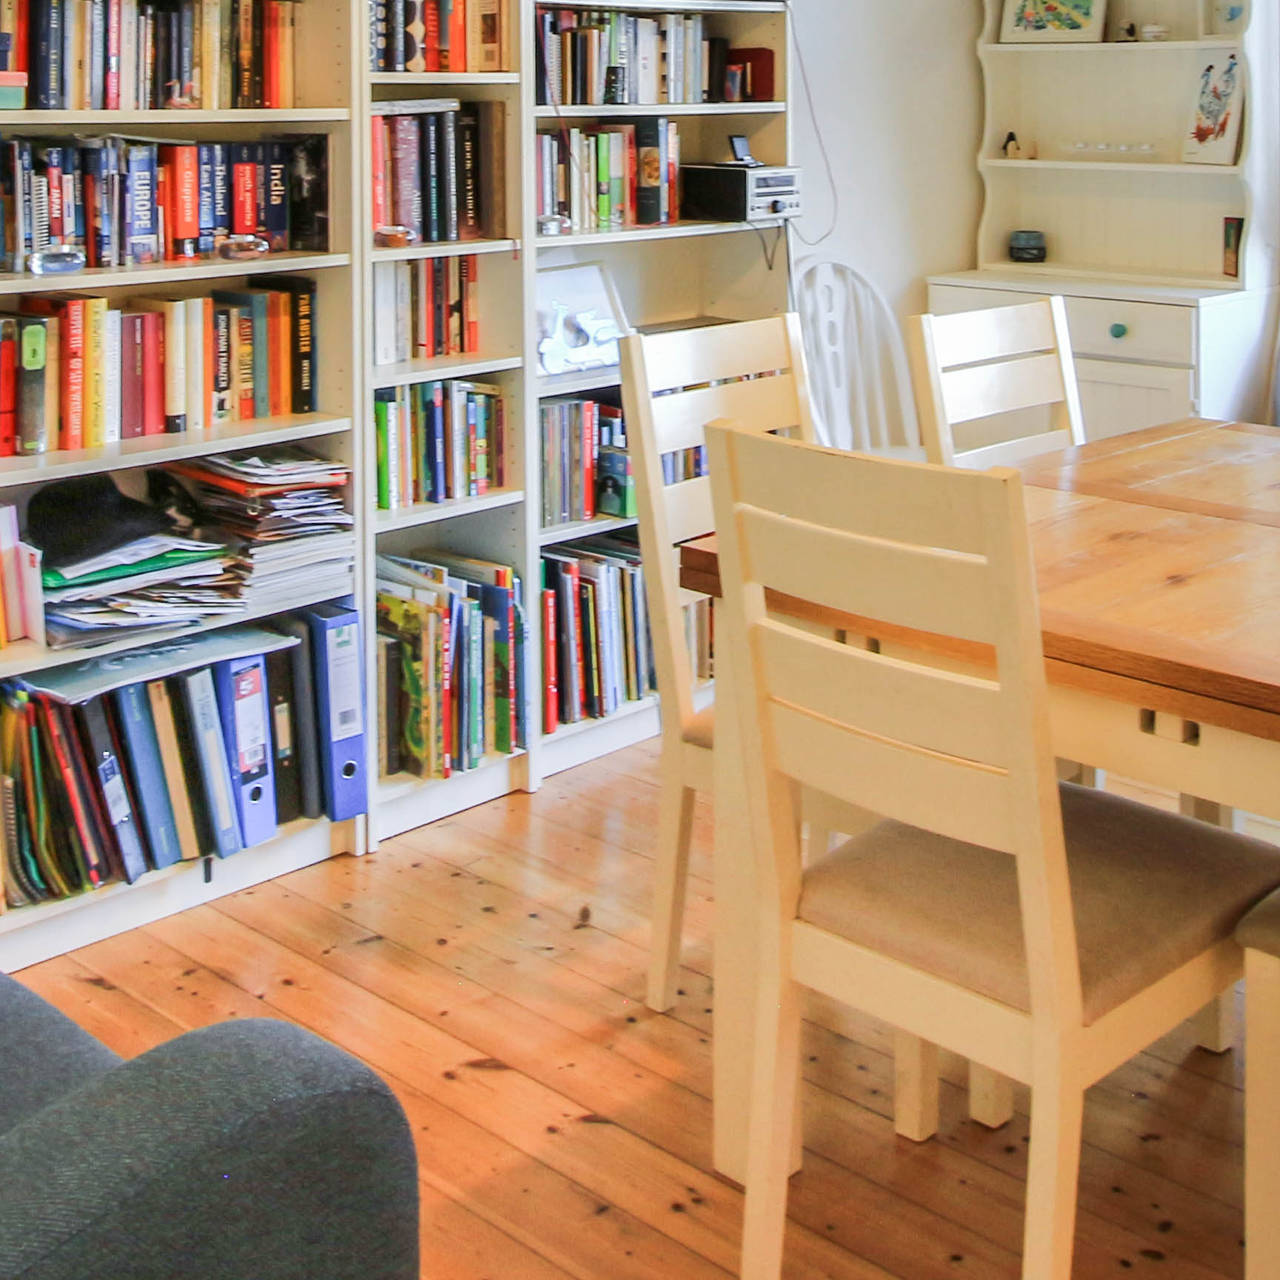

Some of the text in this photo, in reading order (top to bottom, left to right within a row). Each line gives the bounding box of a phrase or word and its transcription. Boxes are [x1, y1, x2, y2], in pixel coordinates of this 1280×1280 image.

[51, 188, 61, 218] JAPAN
[134, 171, 151, 229] EUROPE
[200, 164, 212, 222] East Africa
[215, 164, 227, 216] Thailand
[270, 164, 285, 205] India
[298, 294, 311, 317] PAUL
[218, 314, 228, 388] JONATHAN FRANZEN
[298, 318, 311, 353] AUSTER
